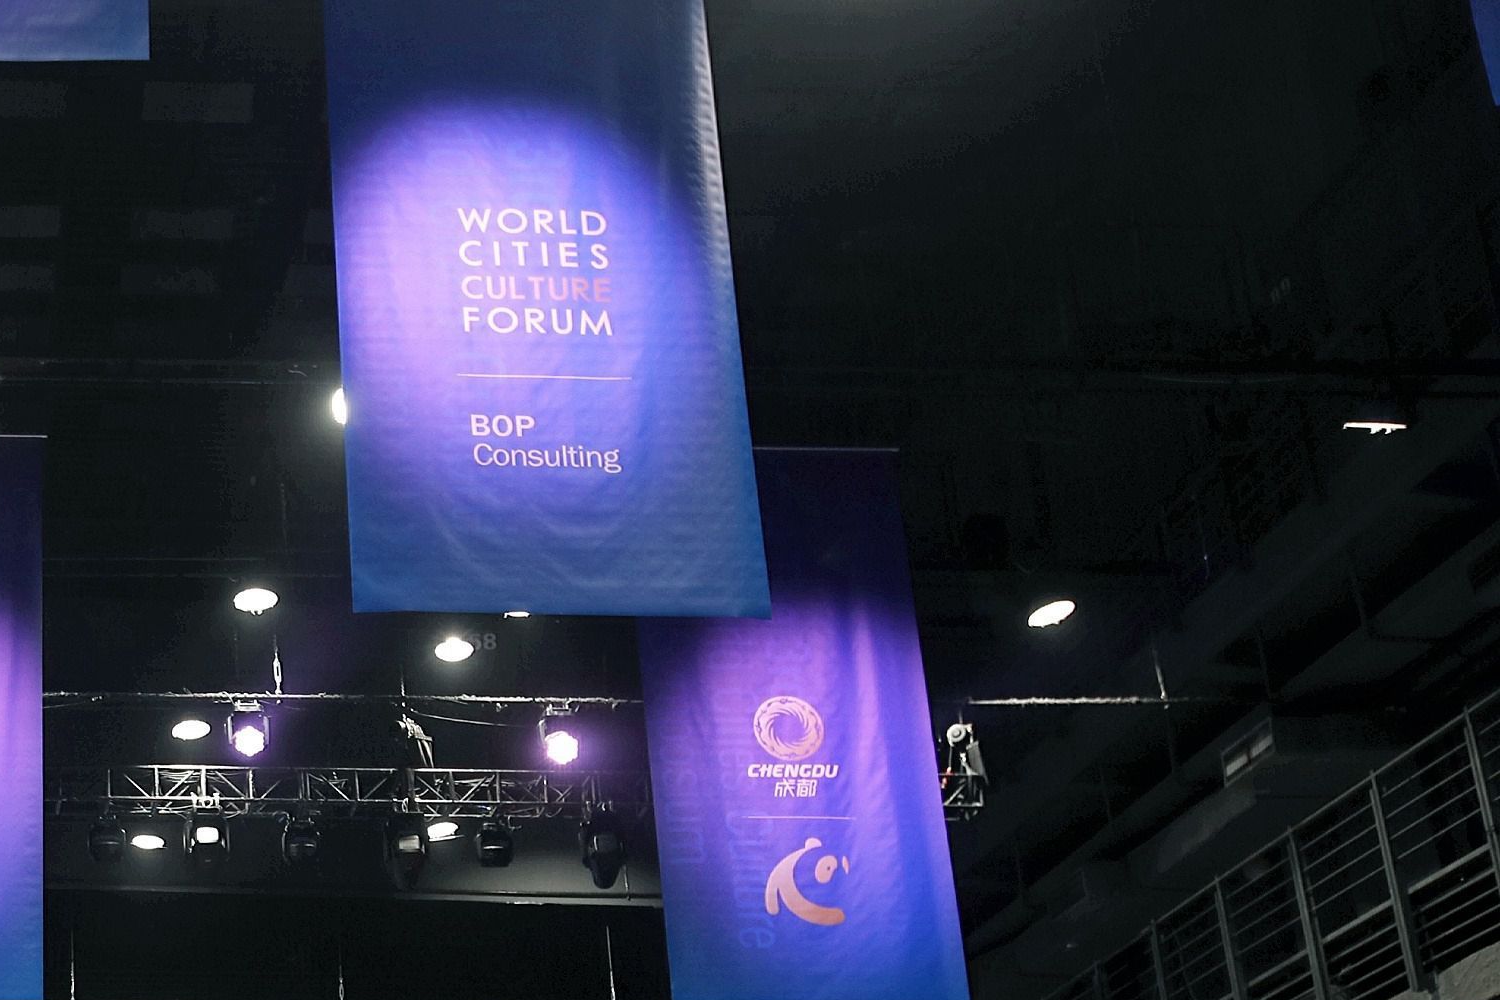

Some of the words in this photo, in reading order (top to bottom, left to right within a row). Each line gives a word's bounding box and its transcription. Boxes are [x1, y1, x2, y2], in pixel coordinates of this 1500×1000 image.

[457, 207, 607, 237] WORLD
[458, 240, 610, 271] CITIES
[460, 275, 613, 305] CULTURE
[462, 305, 615, 337] FORUM
[469, 413, 536, 438] BOP
[472, 443, 623, 475] Consulting
[746, 763, 840, 778] CHENGDU
[773, 778, 818, 798] 成都
